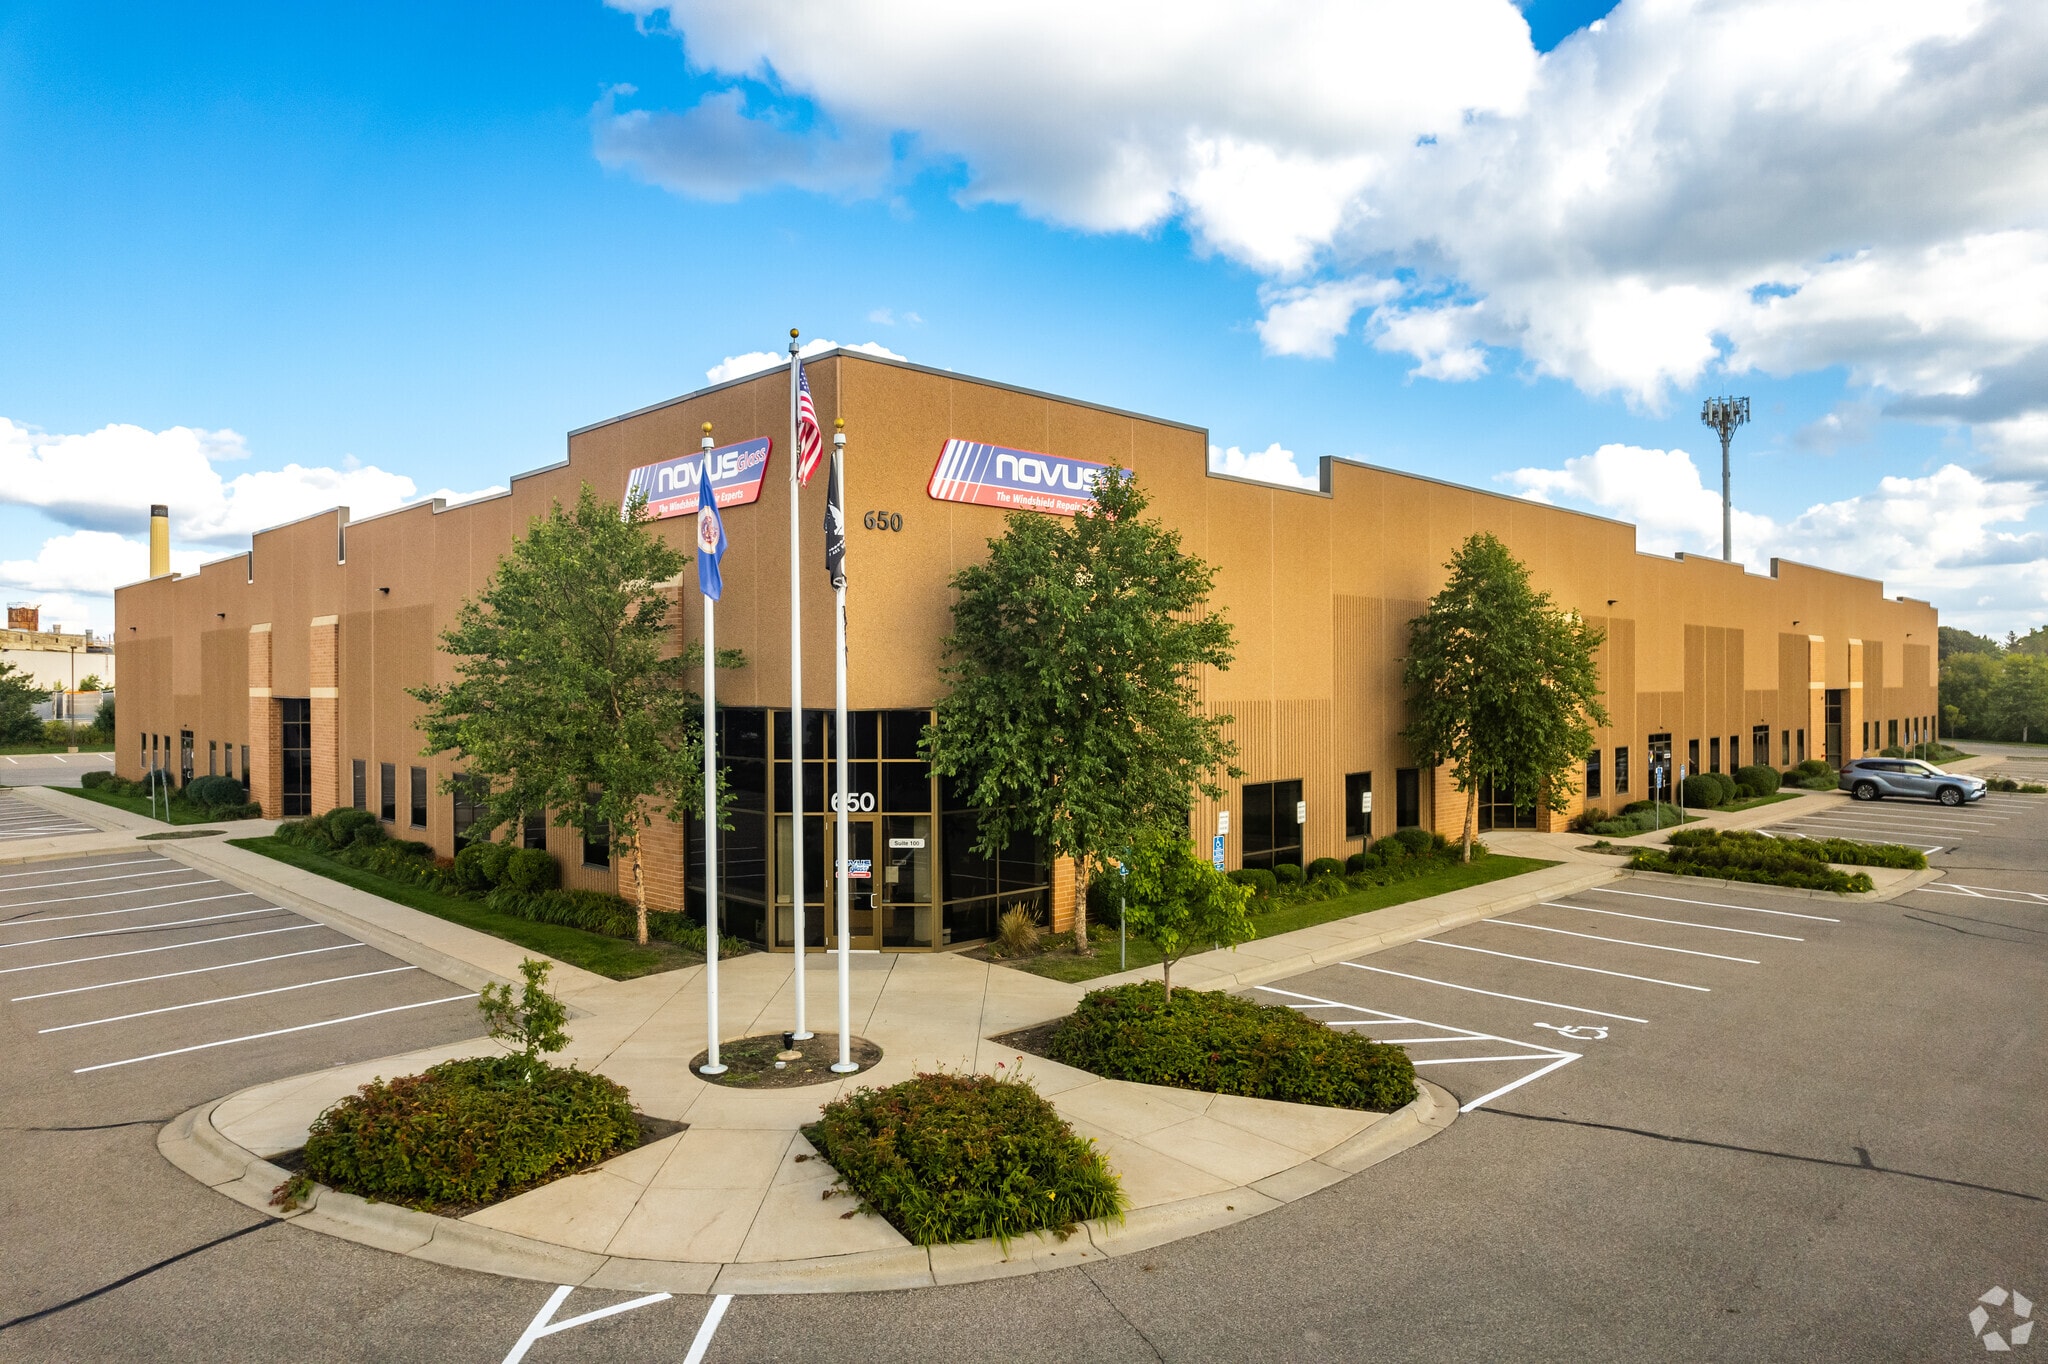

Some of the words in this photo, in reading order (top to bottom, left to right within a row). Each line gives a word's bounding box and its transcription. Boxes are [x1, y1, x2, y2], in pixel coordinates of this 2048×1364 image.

[737, 447, 766, 472] Glass
[659, 504, 668, 512] The
[721, 490, 743, 503] Experts
[996, 491, 1010, 502] The
[1013, 493, 1054, 508] Windshield
[1056, 500, 1080, 512] Repair
[864, 510, 903, 532] 650
